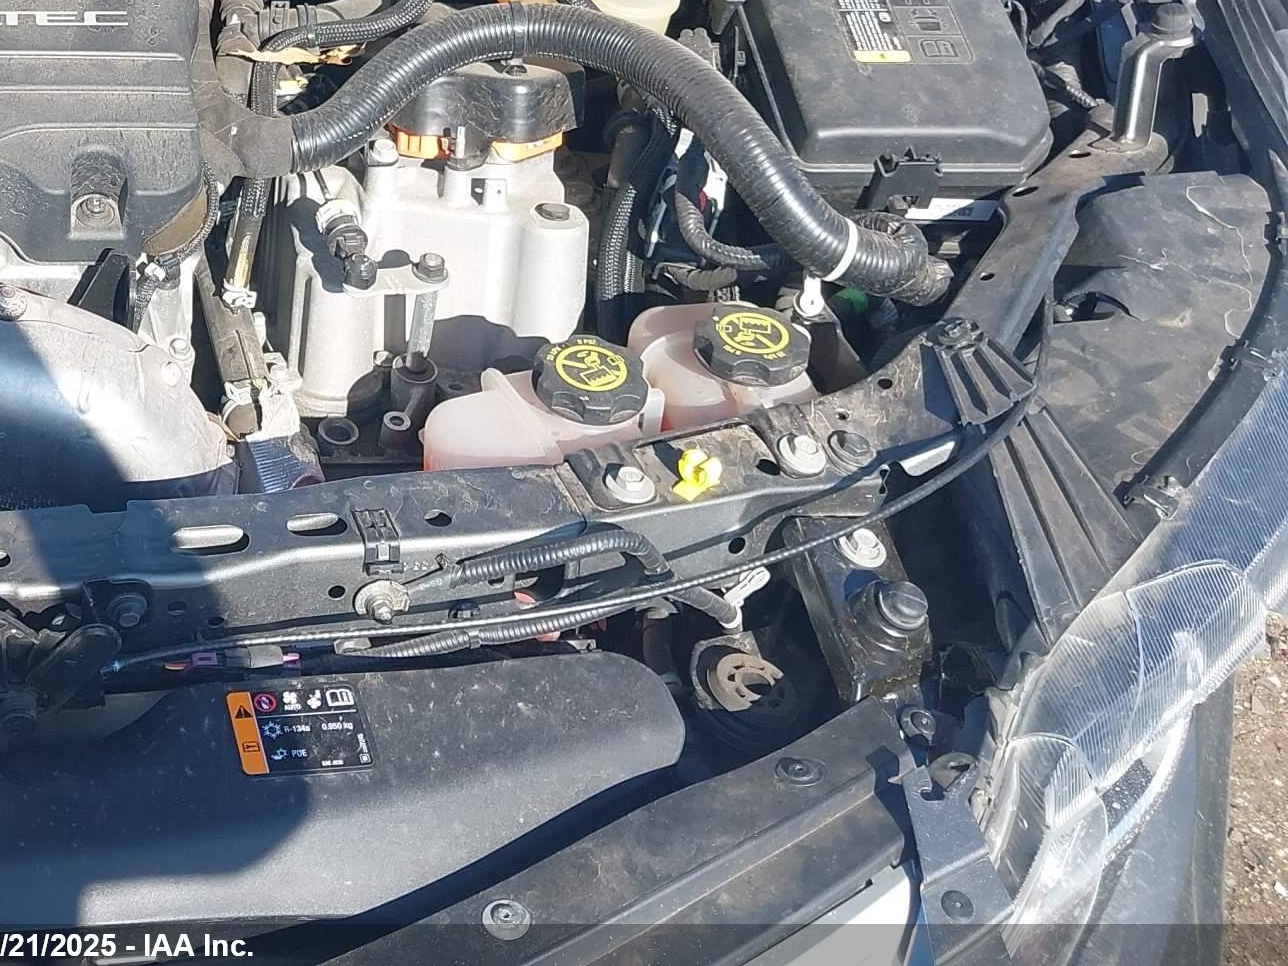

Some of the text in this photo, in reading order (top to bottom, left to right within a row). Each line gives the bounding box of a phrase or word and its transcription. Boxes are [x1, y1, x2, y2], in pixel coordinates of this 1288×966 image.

[283, 724, 311, 732] R-134a
[321, 721, 354, 731] 0.950 kg
[291, 748, 308, 758] POE
